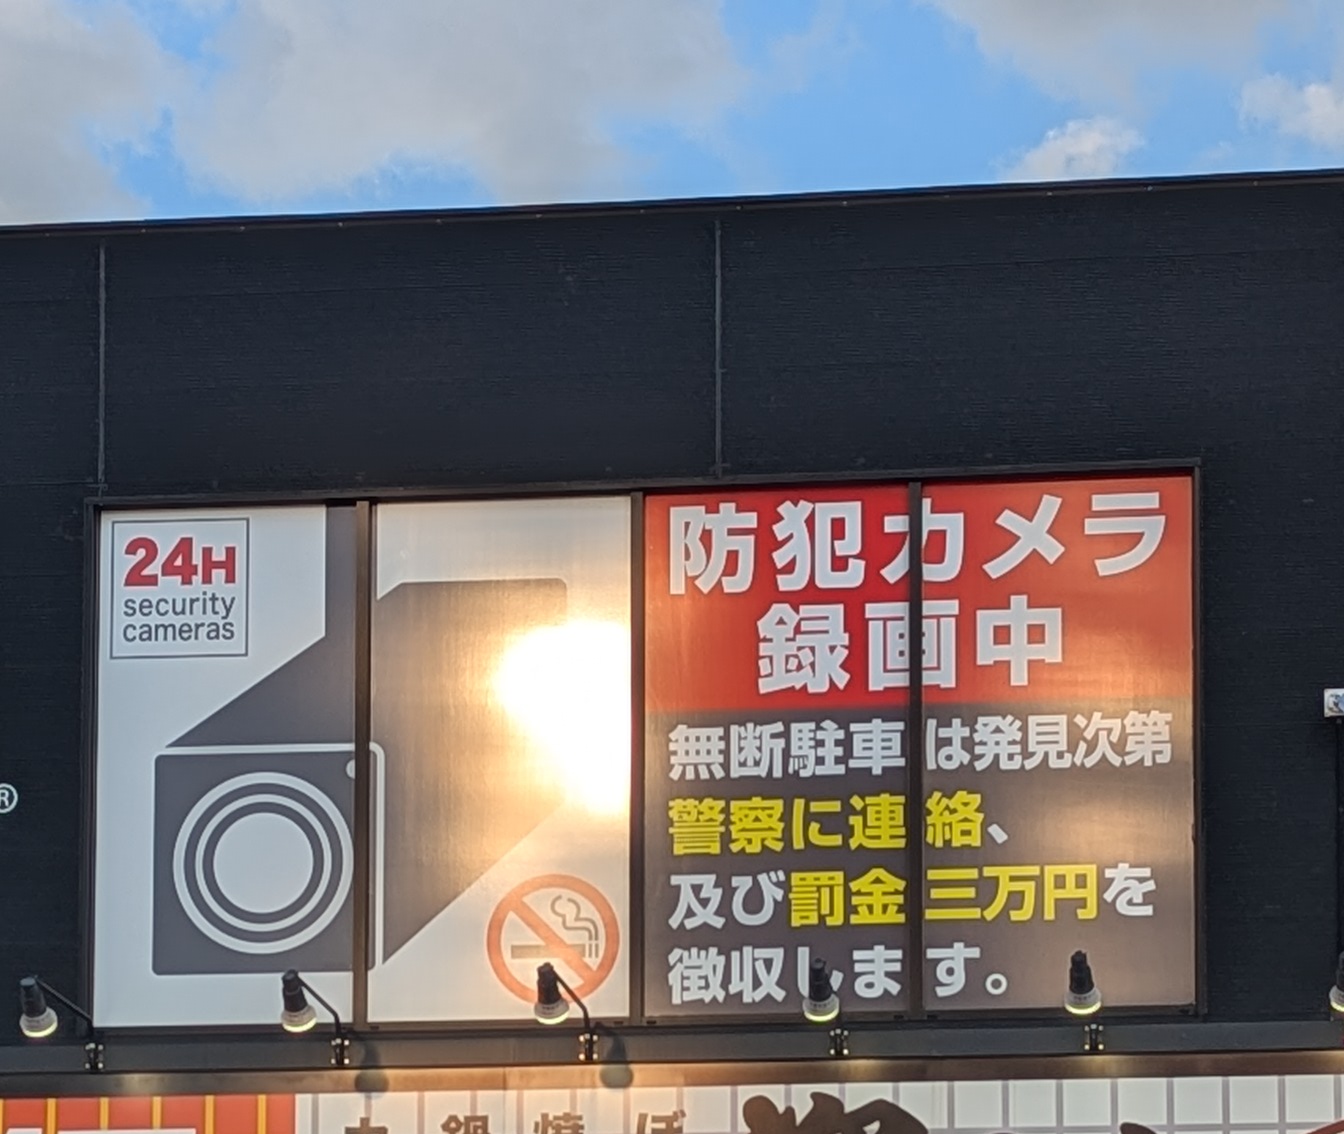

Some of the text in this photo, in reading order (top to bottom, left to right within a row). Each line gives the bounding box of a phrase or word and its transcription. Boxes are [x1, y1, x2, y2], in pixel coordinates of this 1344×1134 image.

[123, 536, 236, 588] 24H
[668, 491, 1167, 595] 防犯カメラ
[122, 590, 236, 620] security
[122, 618, 235, 643] cameras
[756, 594, 1063, 694] 録画中
[667, 710, 1174, 781] 無断駐車は発見次第
[667, 791, 1009, 856] 警察に連絡、
[667, 862, 1157, 931] 及び罰金三万円を
[667, 942, 1009, 1005] 徴収します。
